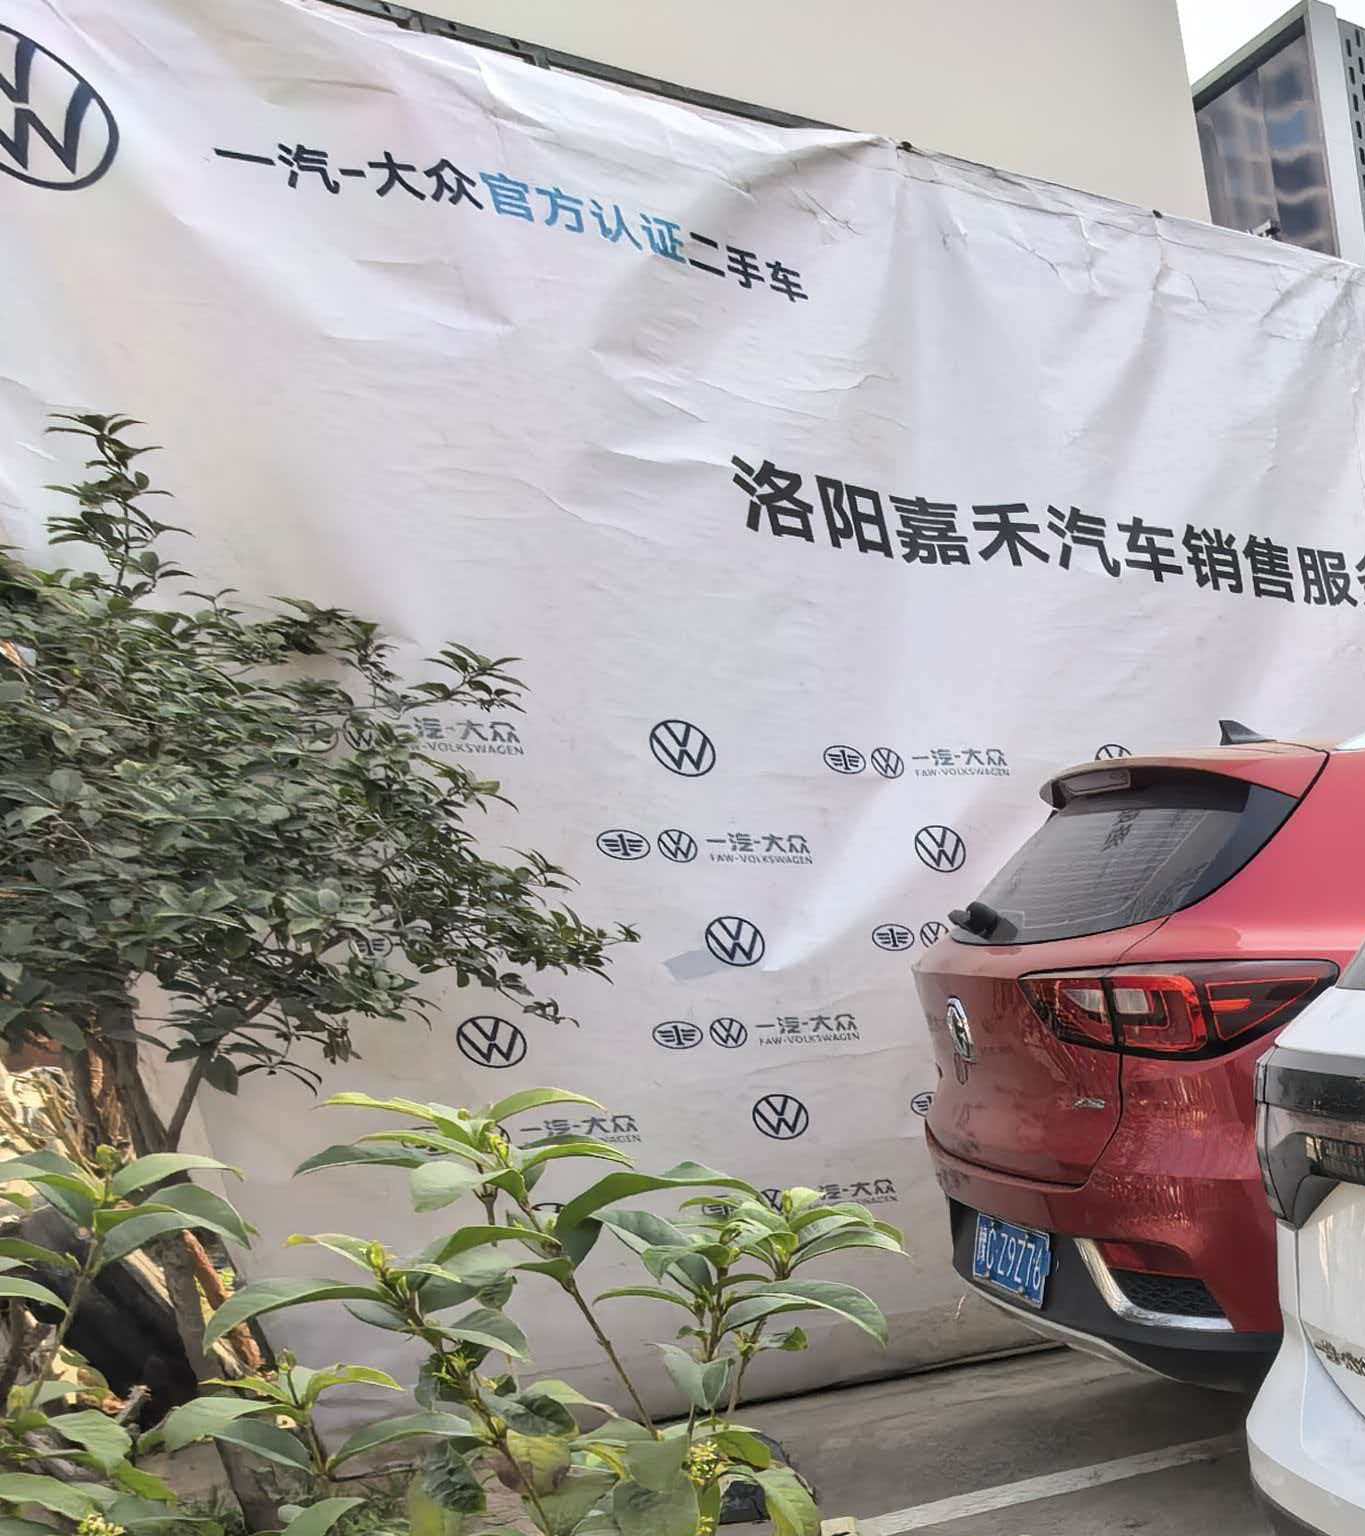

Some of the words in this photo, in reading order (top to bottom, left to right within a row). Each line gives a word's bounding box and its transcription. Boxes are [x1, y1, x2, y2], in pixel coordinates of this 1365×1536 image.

[912, 748, 1008, 766] 一汽-大众
[706, 832, 811, 854] 一汽-大众
[755, 1013, 859, 1034] 一汽-大众
[819, 1179, 897, 1201] 汽-大众
